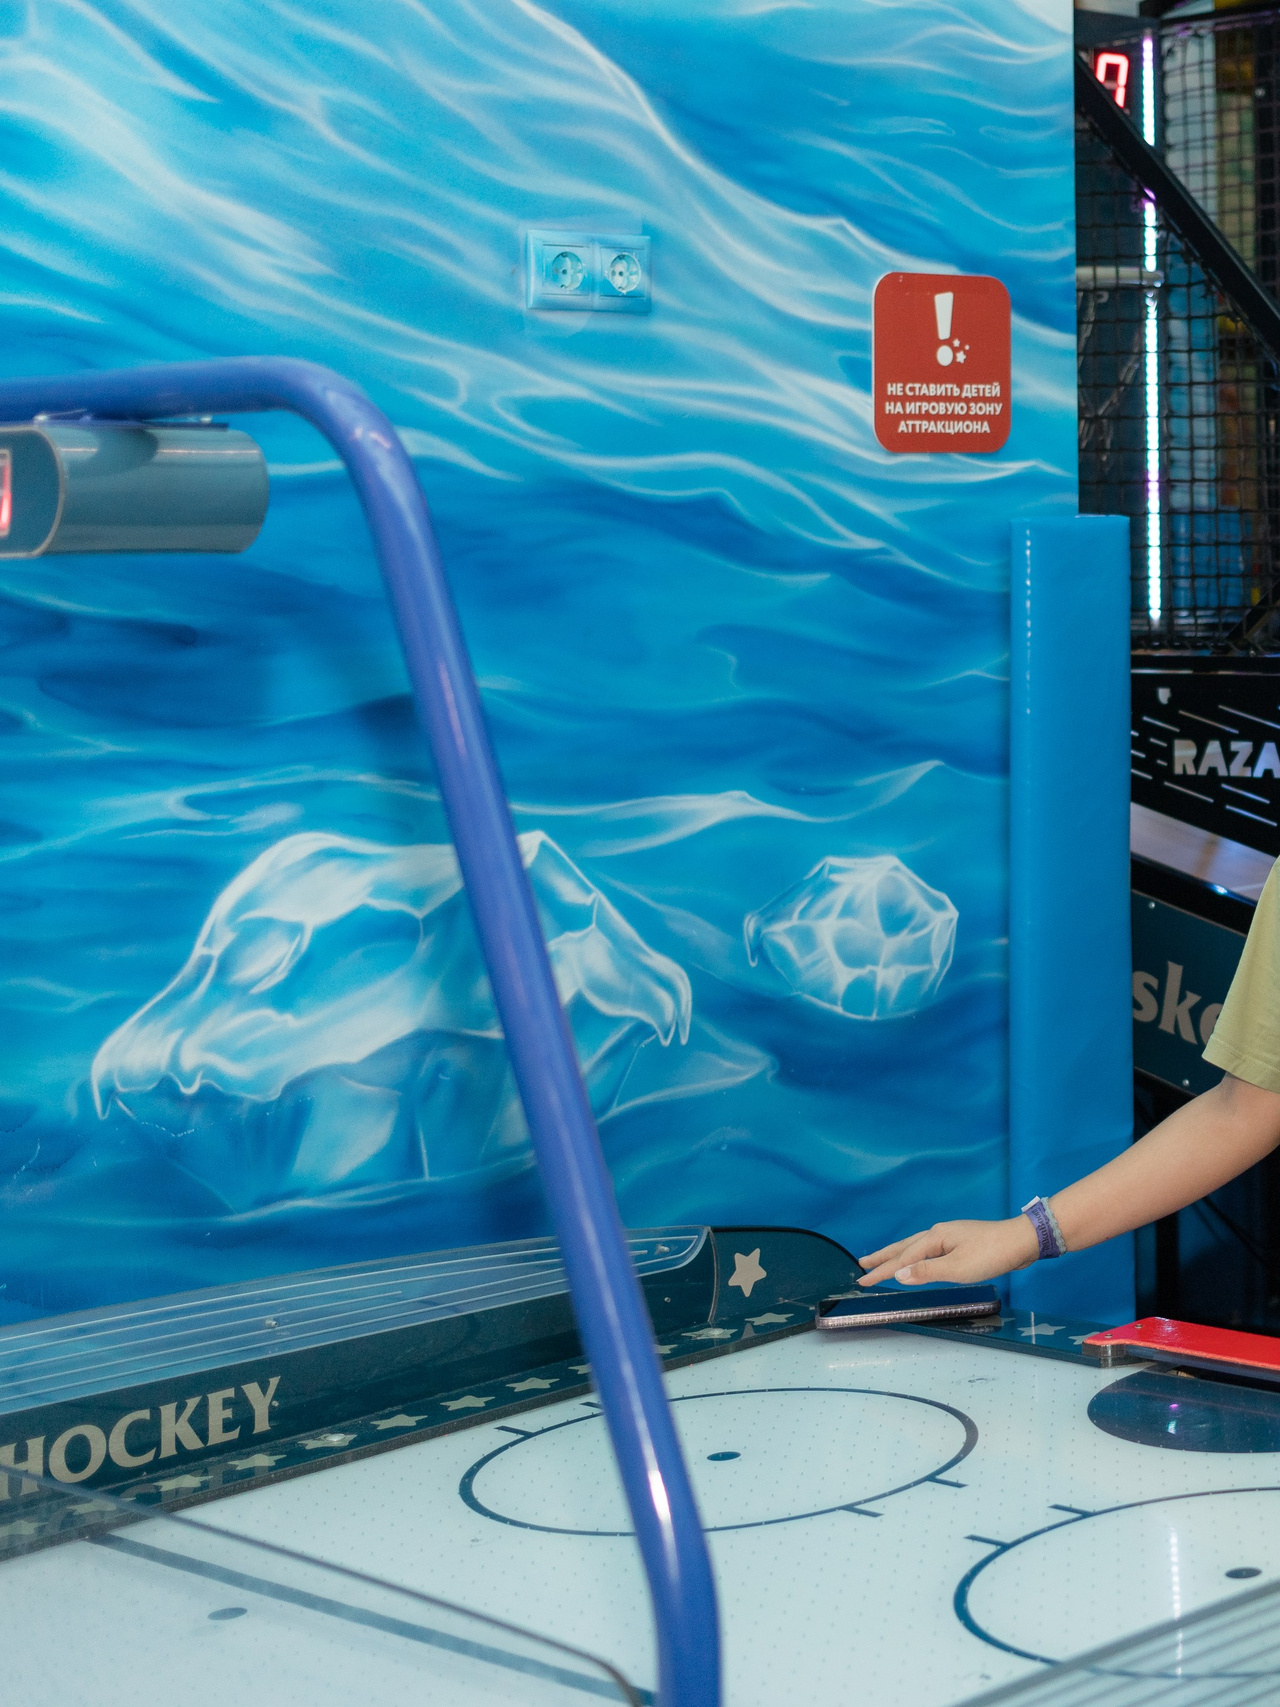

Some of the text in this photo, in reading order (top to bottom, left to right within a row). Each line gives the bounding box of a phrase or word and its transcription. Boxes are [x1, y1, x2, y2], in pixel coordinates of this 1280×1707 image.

[887, 382, 1001, 398] НЕ СТАВИТЬ ДЕТЕЙ
[885, 402, 1003, 415] НА ИГРОВУЮ ЗОНУ
[898, 420, 990, 435] АТТРАКЦИОНА
[0, 1375, 281, 1502] HOCKEY
